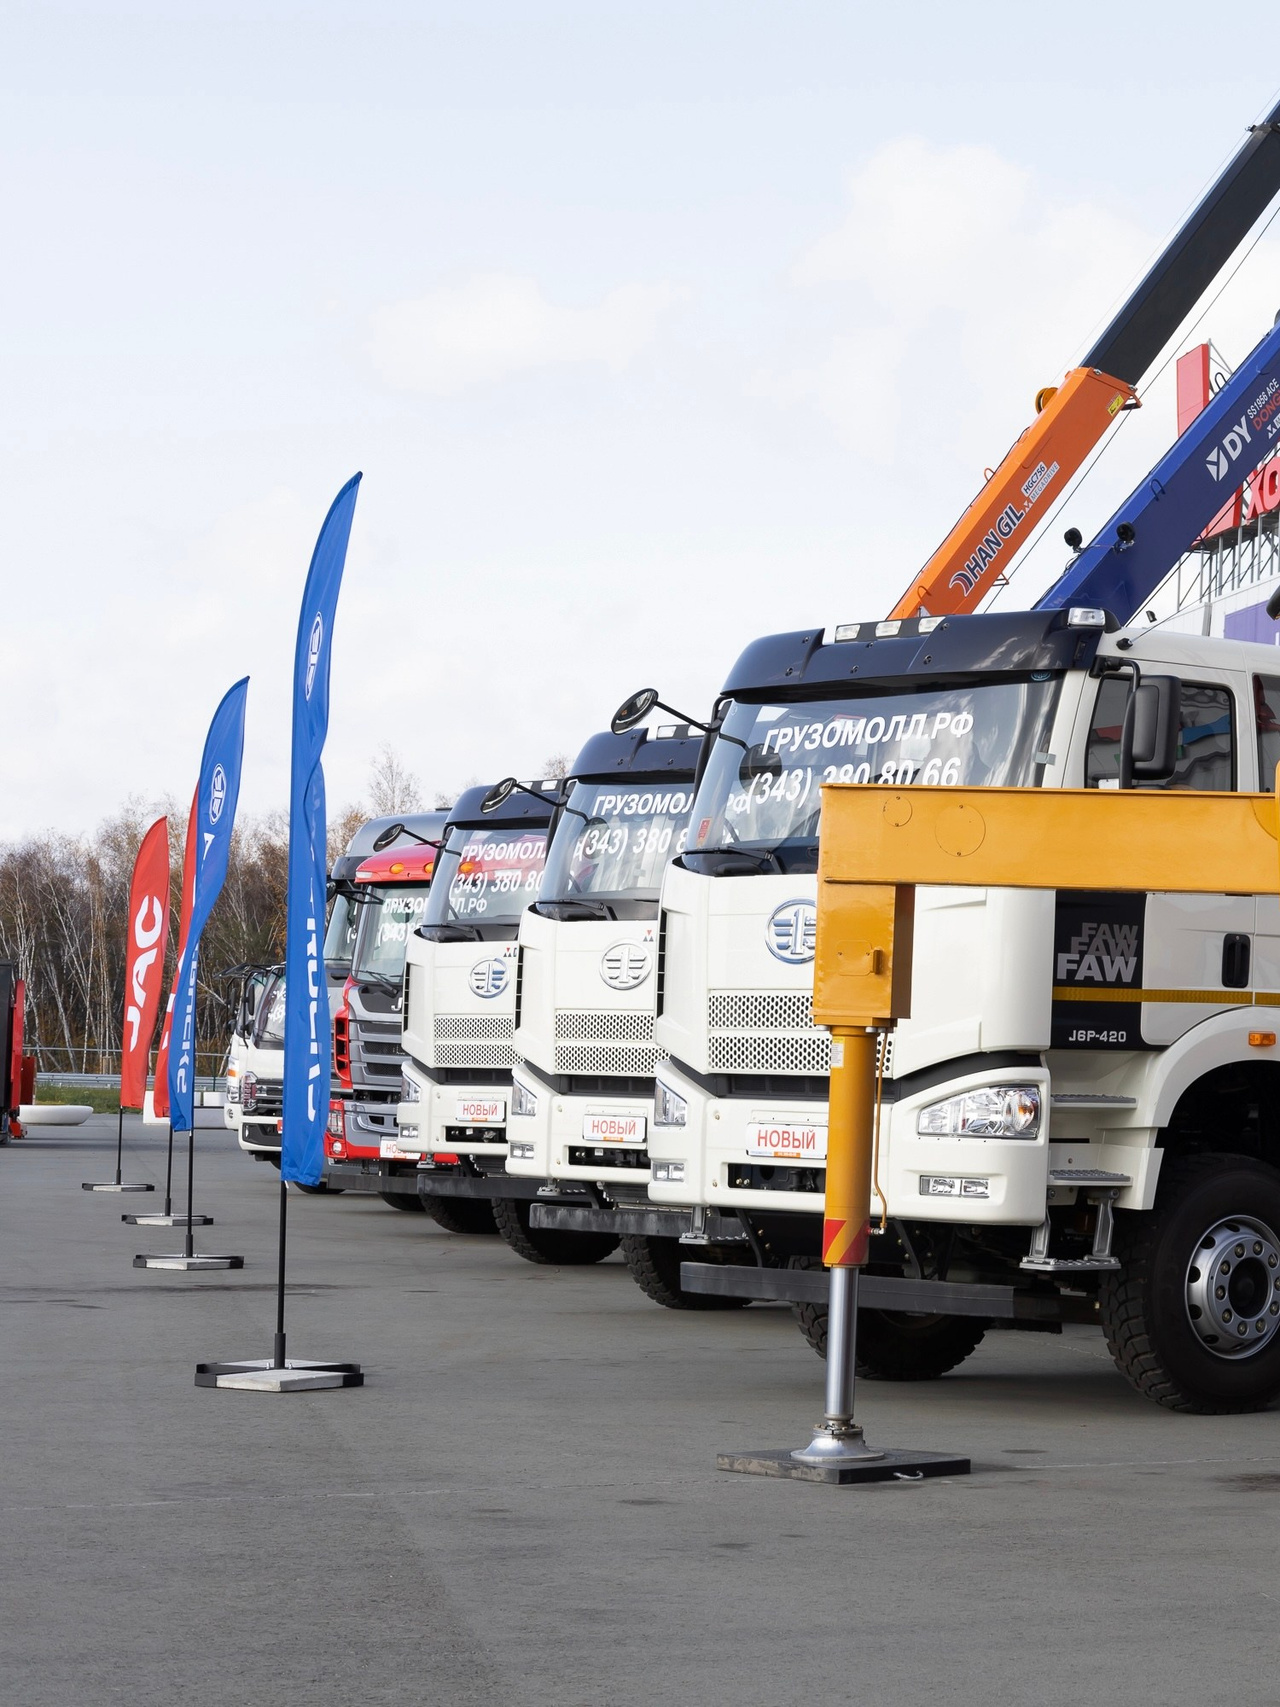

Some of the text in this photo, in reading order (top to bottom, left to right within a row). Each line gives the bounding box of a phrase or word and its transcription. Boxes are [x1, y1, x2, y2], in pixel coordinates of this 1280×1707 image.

[1247, 378, 1280, 419] SS1956 ACE
[1023, 464, 1046, 495] HGC756
[1030, 463, 1059, 500] MEGADRIVE
[762, 711, 974, 755] ГРУЗОМОЛЛ.РФ
[747, 767, 812, 813] (343)
[579, 828, 629, 861] (343)
[633, 828, 672, 854] 380
[449, 872, 488, 899] (343)
[491, 871, 522, 892] 380
[1081, 922, 1138, 944] FAW
[1071, 936, 1137, 960] FAW
[127, 895, 163, 1052] JAC
[1057, 953, 1137, 982] FAW
[1069, 1030, 1126, 1042] J6P-420
[463, 1102, 498, 1116] НОВЫЙ
[592, 1120, 636, 1136] НОВЫЙ
[757, 1129, 816, 1150] НОВЫЙ
